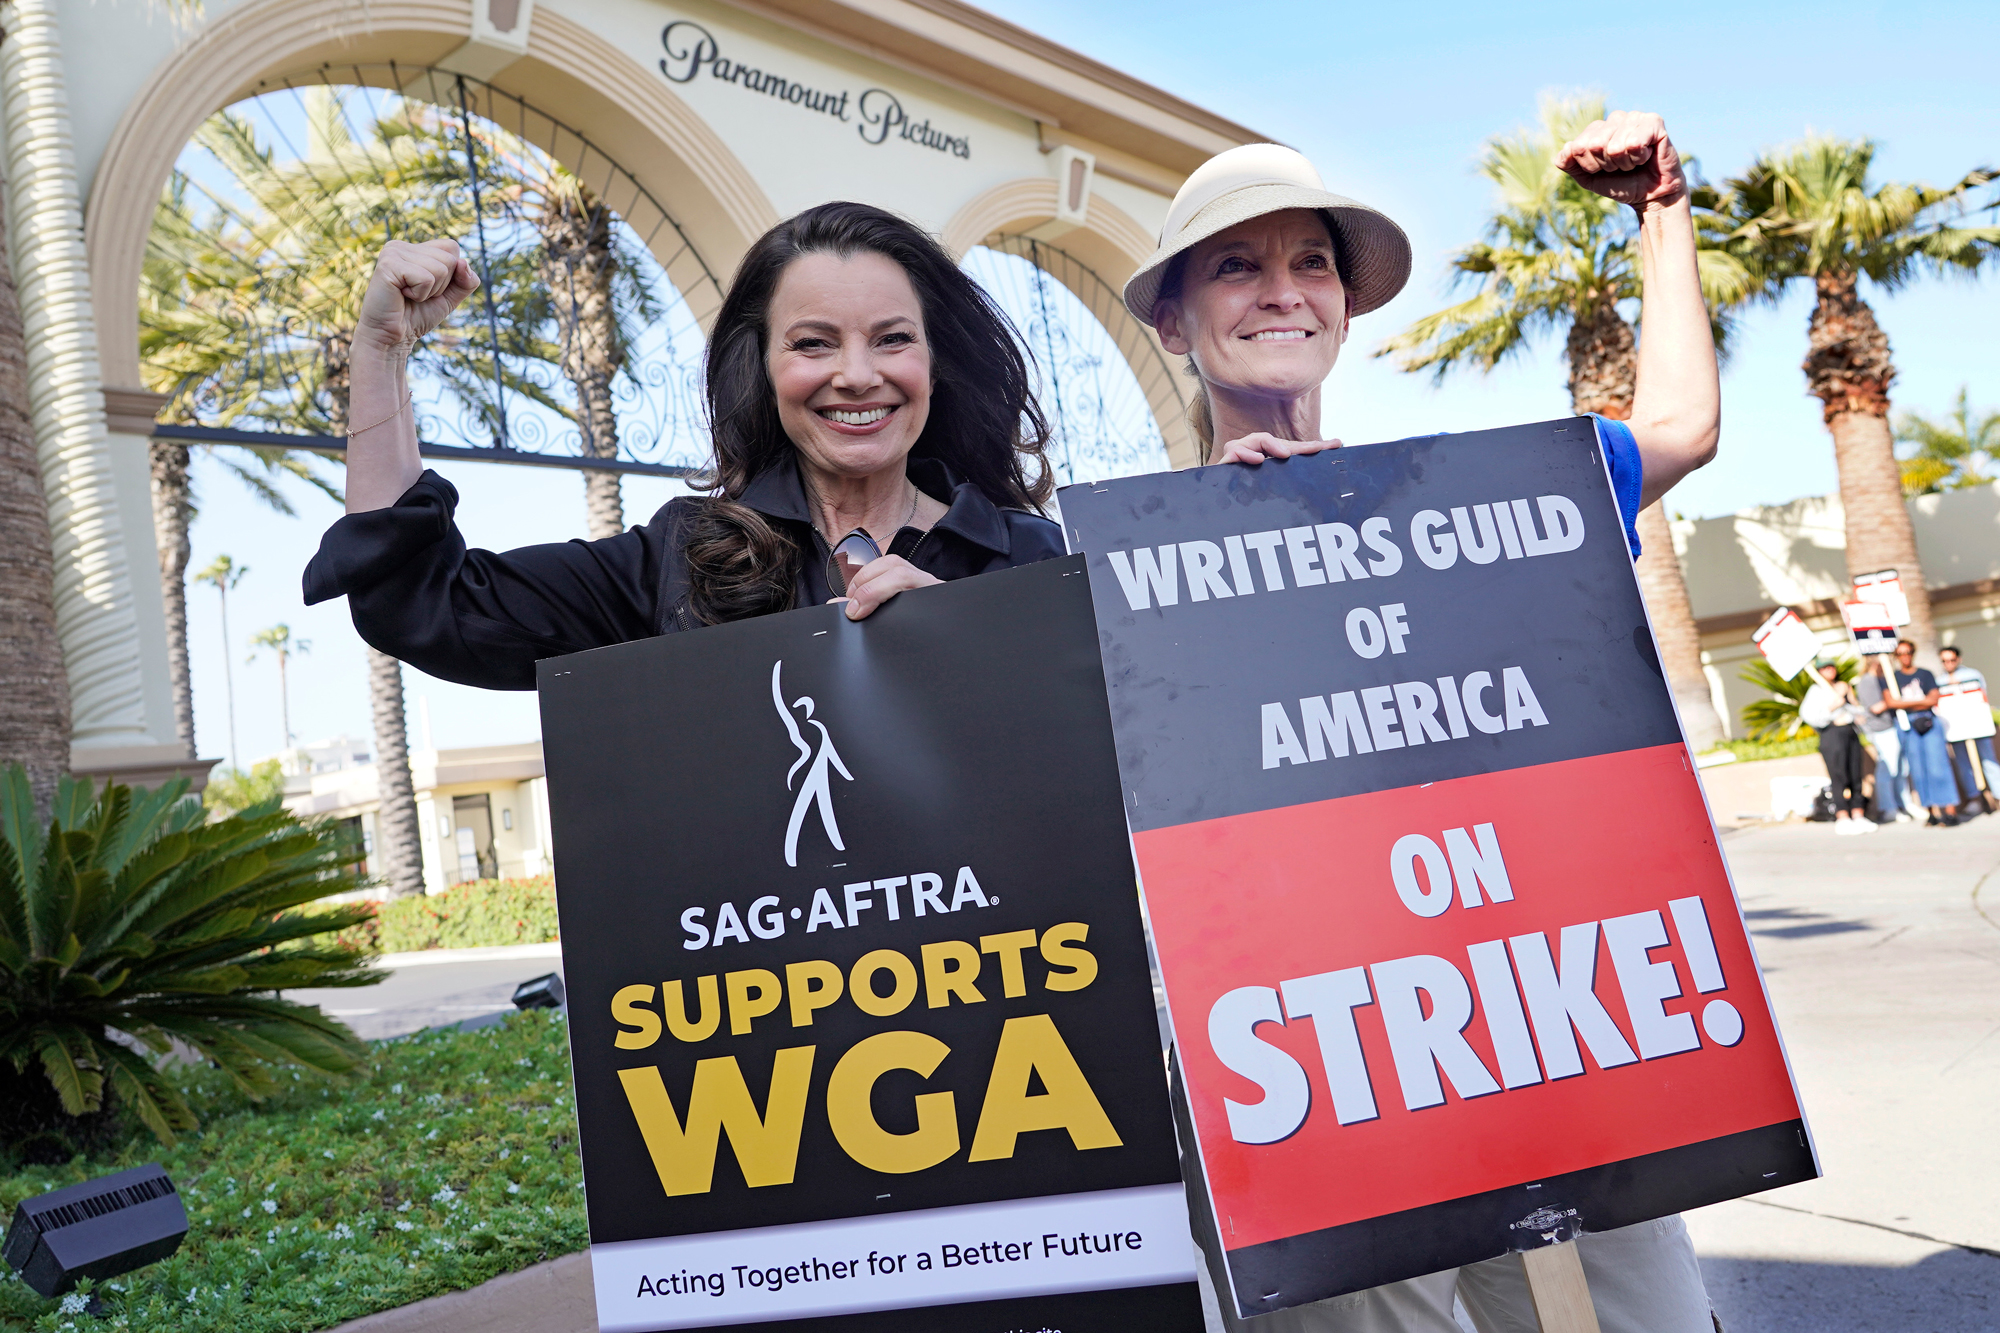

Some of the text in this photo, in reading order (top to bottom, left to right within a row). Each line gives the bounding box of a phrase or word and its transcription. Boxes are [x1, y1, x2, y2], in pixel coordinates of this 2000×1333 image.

[659, 20, 970, 160] Paramount Pictures
[1107, 495, 1585, 610] WRITERS GUILD
[1346, 603, 1411, 659] OF
[1261, 666, 1549, 769] AMERICA
[1390, 822, 1515, 918] ON
[611, 922, 1098, 1050] SUPPORTS
[1207, 896, 1745, 1146] STRIKE!
[617, 1014, 1123, 1196] WGA
[637, 1226, 1142, 1298] Acting Together for a Better Future
